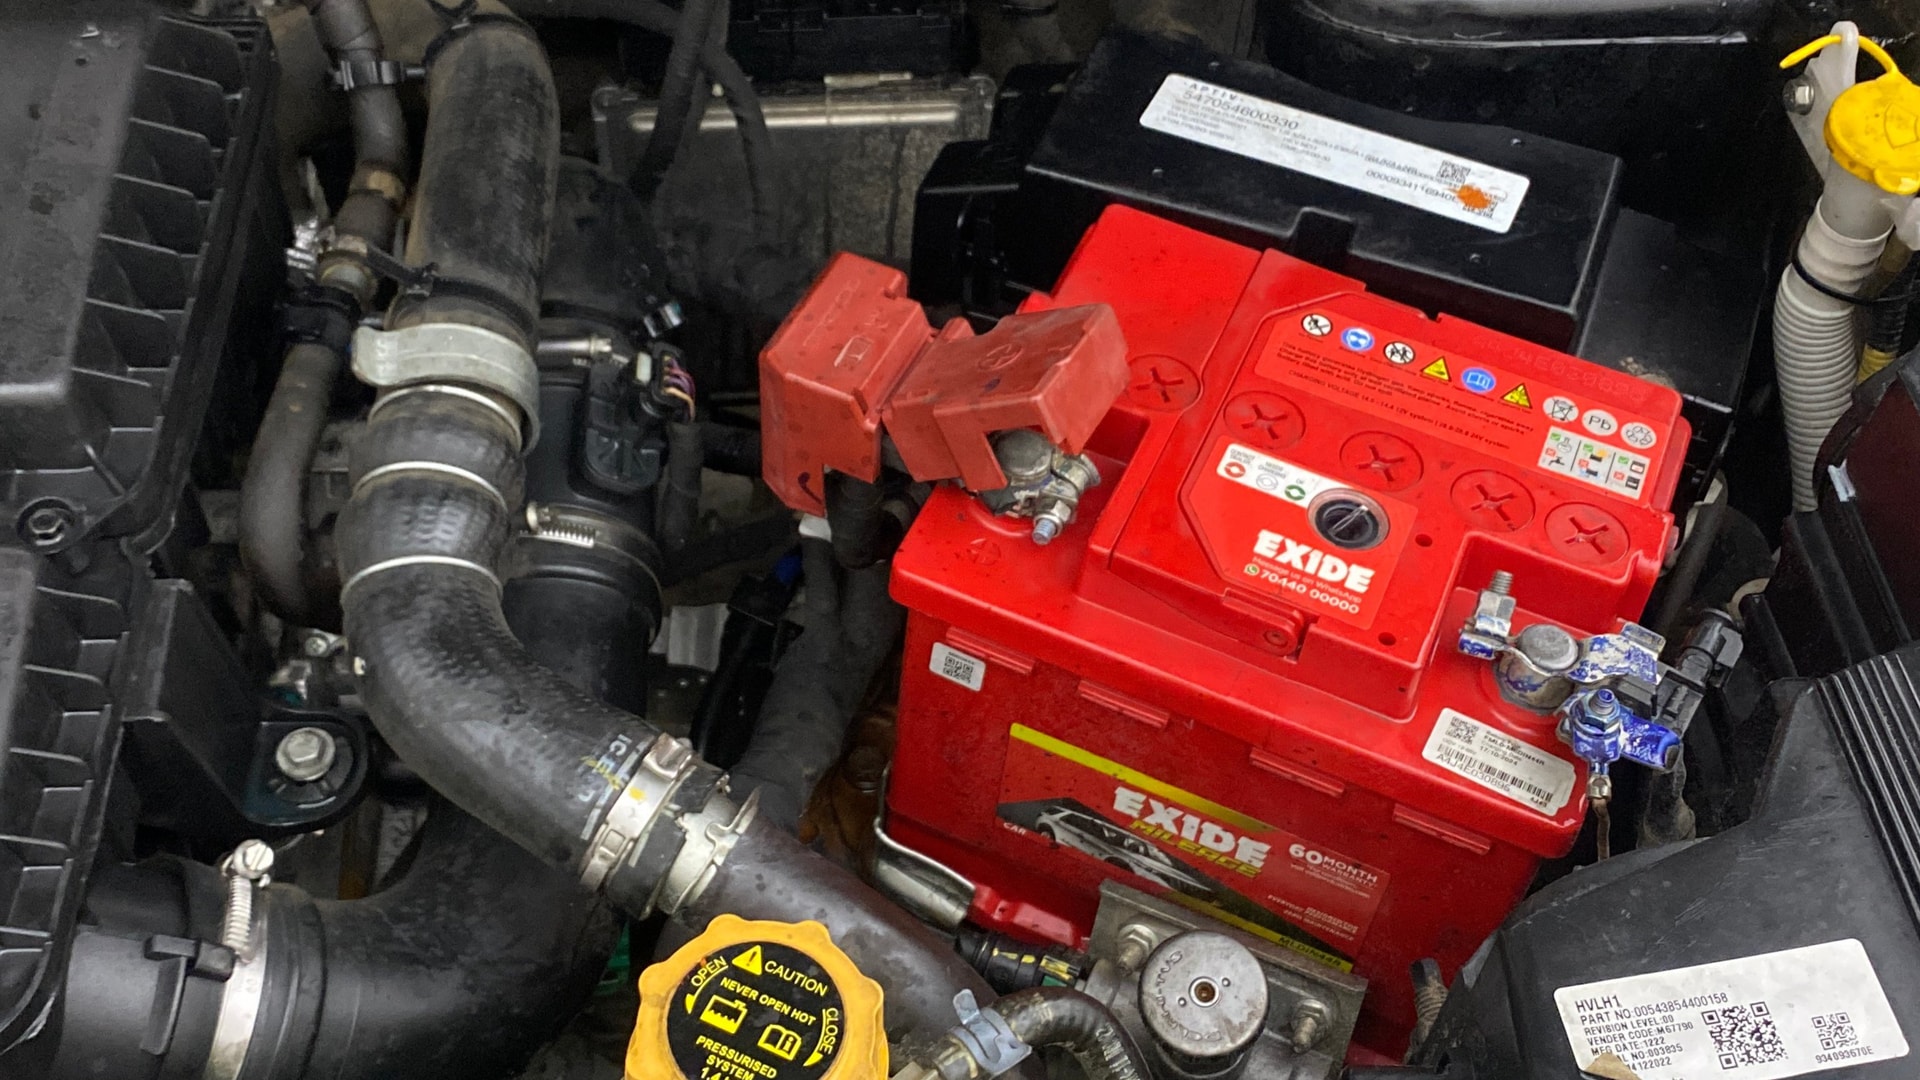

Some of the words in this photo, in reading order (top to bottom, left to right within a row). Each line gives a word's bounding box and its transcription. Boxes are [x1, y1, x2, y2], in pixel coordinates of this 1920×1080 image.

[1184, 89, 1298, 130] 547054600330
[1587, 414, 1612, 431] Pb
[1253, 529, 1375, 593] EXIDE
[1261, 569, 1307, 593] 70440
[1309, 588, 1359, 613] 00000
[1003, 822, 1027, 836] CAR
[1113, 786, 1272, 868] EXIDE
[1129, 820, 1263, 878] MILEAGE
[1289, 843, 1323, 865] 60
[1323, 855, 1378, 882] MONTH
[690, 955, 727, 987] OPEN
[764, 959, 828, 998] CAUTION
[719, 976, 757, 1001] NEVER
[758, 993, 791, 1016] OPEN
[791, 1006, 817, 1026] HOT
[1574, 994, 1621, 1014] HVLH1
[1580, 1011, 1611, 1026] PART
[820, 1006, 839, 1055] CLOSE
[1583, 1021, 1628, 1037] REVISION
[1629, 1013, 1674, 1030] LEVEL:00
[1587, 1031, 1626, 1047] VENDER
[696, 1034, 778, 1079] PRESSURISED
[1590, 1044, 1613, 1056] MFG
[1614, 1035, 1666, 1053] DATE:1222
[1814, 1045, 1874, 1064] 934093670E
[705, 1054, 755, 1080] SYSTEM
